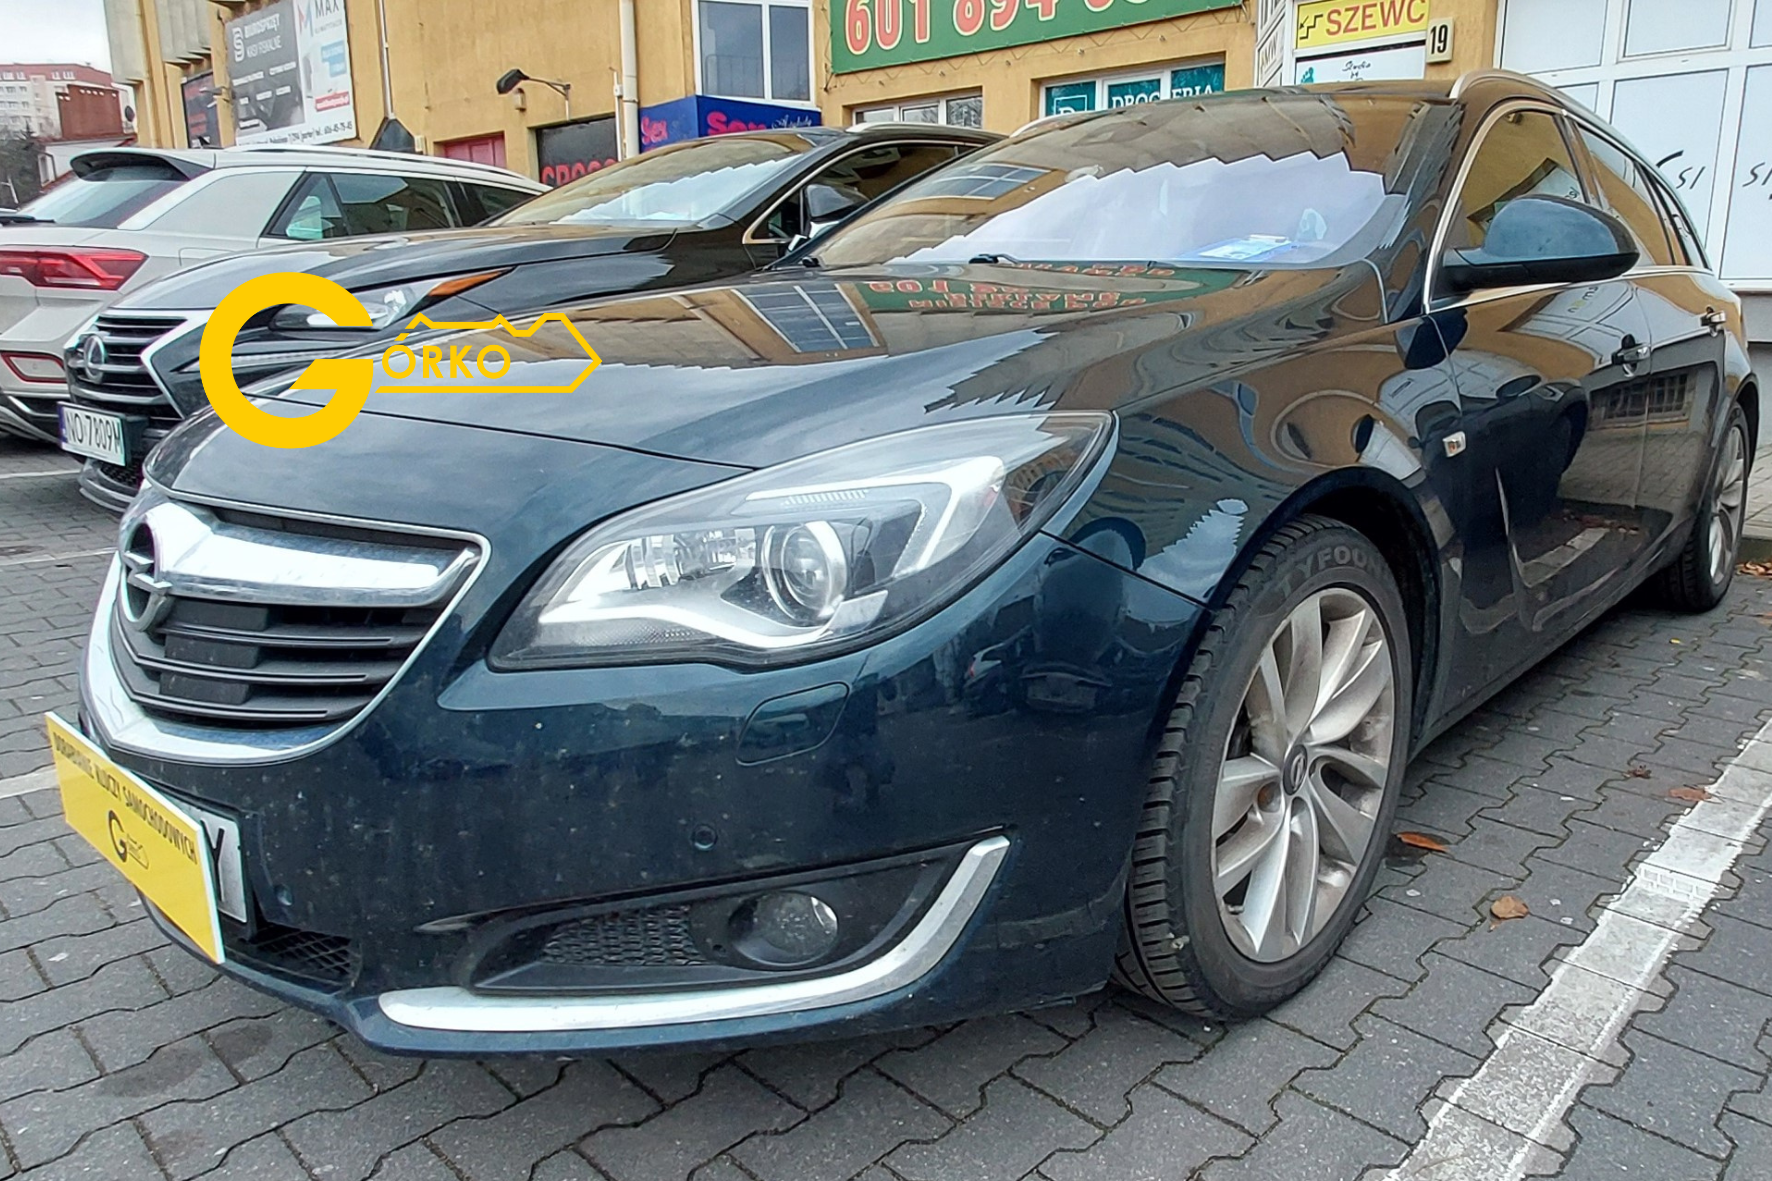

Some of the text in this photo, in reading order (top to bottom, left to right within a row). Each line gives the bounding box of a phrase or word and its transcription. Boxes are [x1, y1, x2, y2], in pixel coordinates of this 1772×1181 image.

[845, 0, 931, 54] 601
[1326, 0, 1425, 35] SZEWC
[1430, 25, 1448, 54] 19
